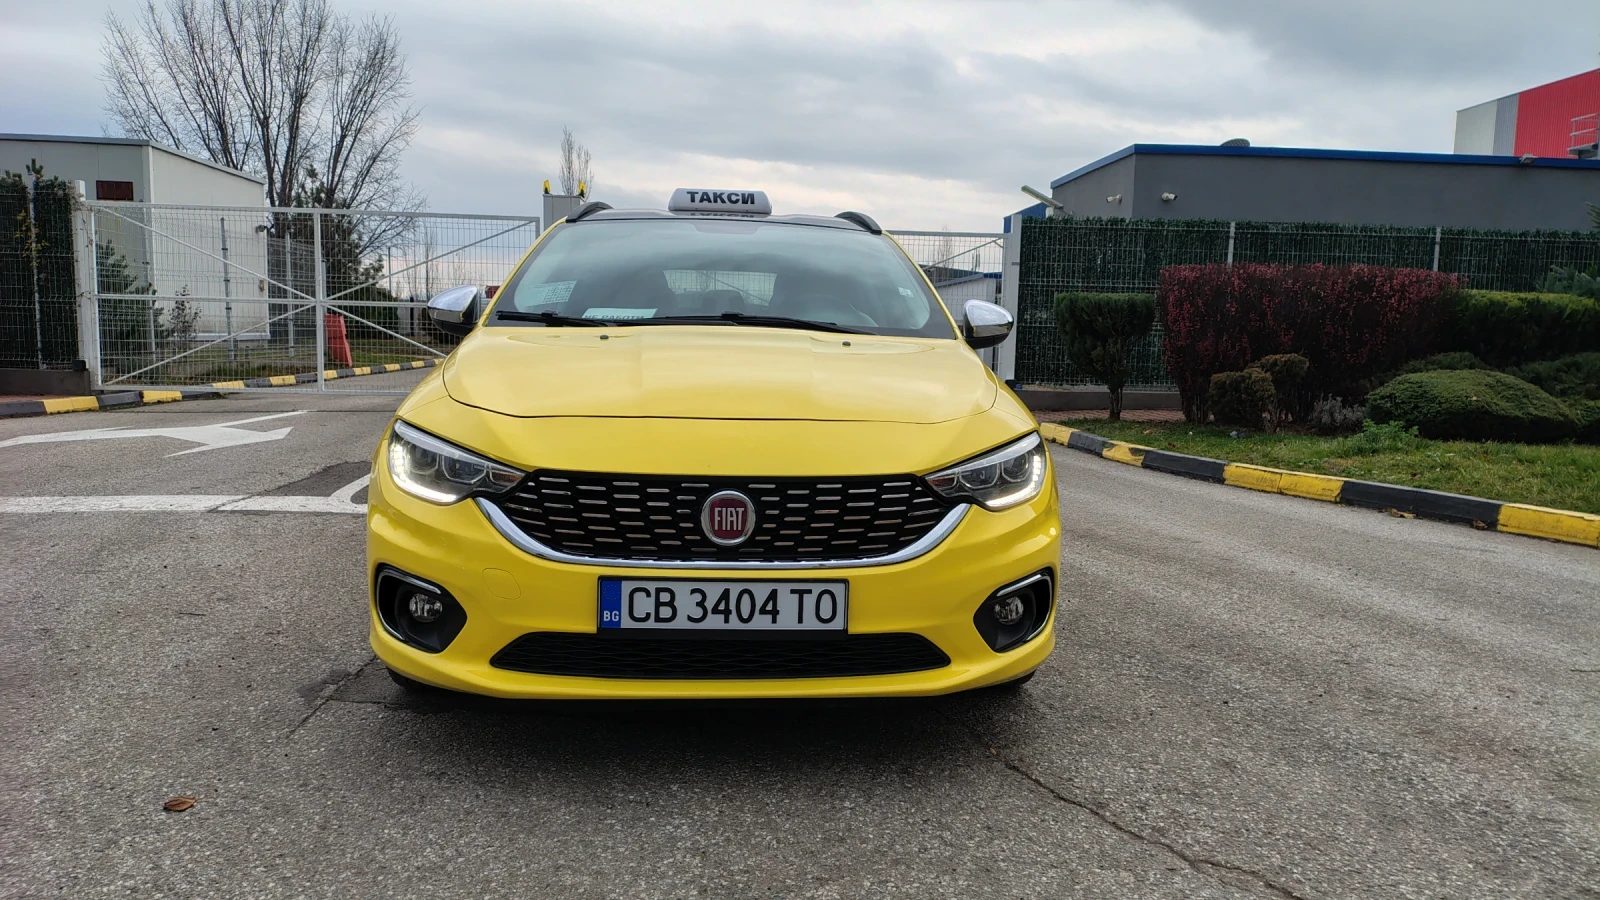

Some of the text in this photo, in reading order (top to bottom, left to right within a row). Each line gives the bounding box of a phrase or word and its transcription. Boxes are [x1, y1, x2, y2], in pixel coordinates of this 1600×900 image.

[686, 191, 755, 205] ТАКСИ
[714, 507, 745, 531] FIAT
[628, 586, 838, 624] CB 3404 TO
[603, 610, 619, 622] BG
